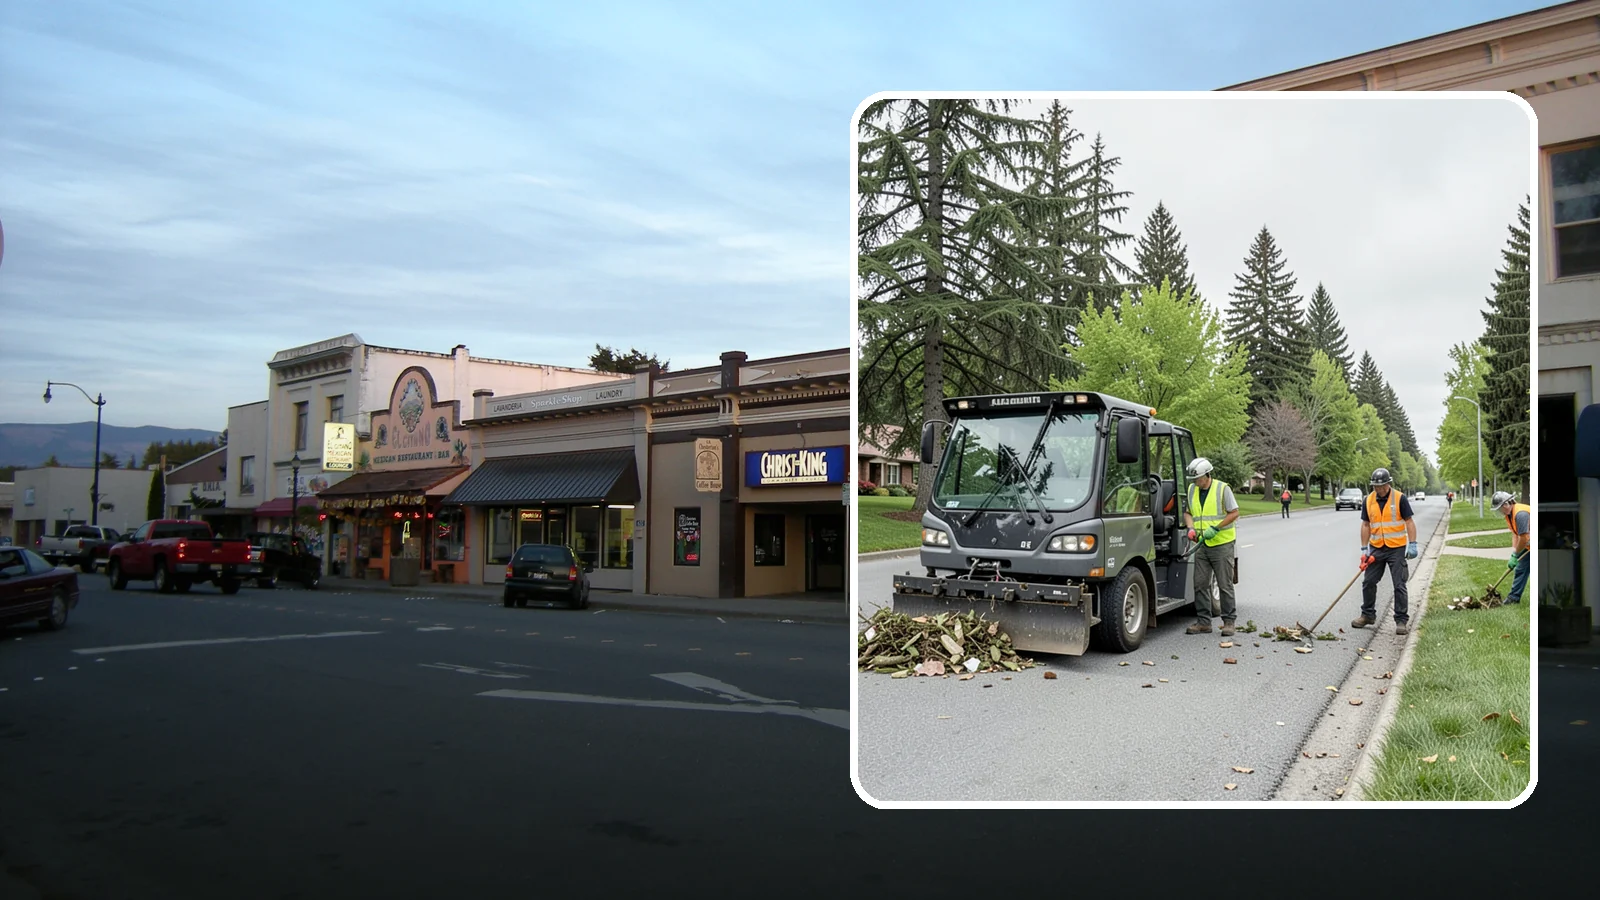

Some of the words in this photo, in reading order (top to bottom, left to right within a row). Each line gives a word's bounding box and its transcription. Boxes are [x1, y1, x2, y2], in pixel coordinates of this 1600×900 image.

[595, 388, 624, 400] LAUNDRY
[493, 402, 523, 413] LAVANDERIA
[530, 396, 560, 409] Sparkle
[561, 394, 583, 404] Shop
[397, 452, 434, 462] RESTAURANT
[438, 450, 450, 459] BAR
[761, 452, 797, 478] CHRIST
[799, 450, 827, 477] KING
